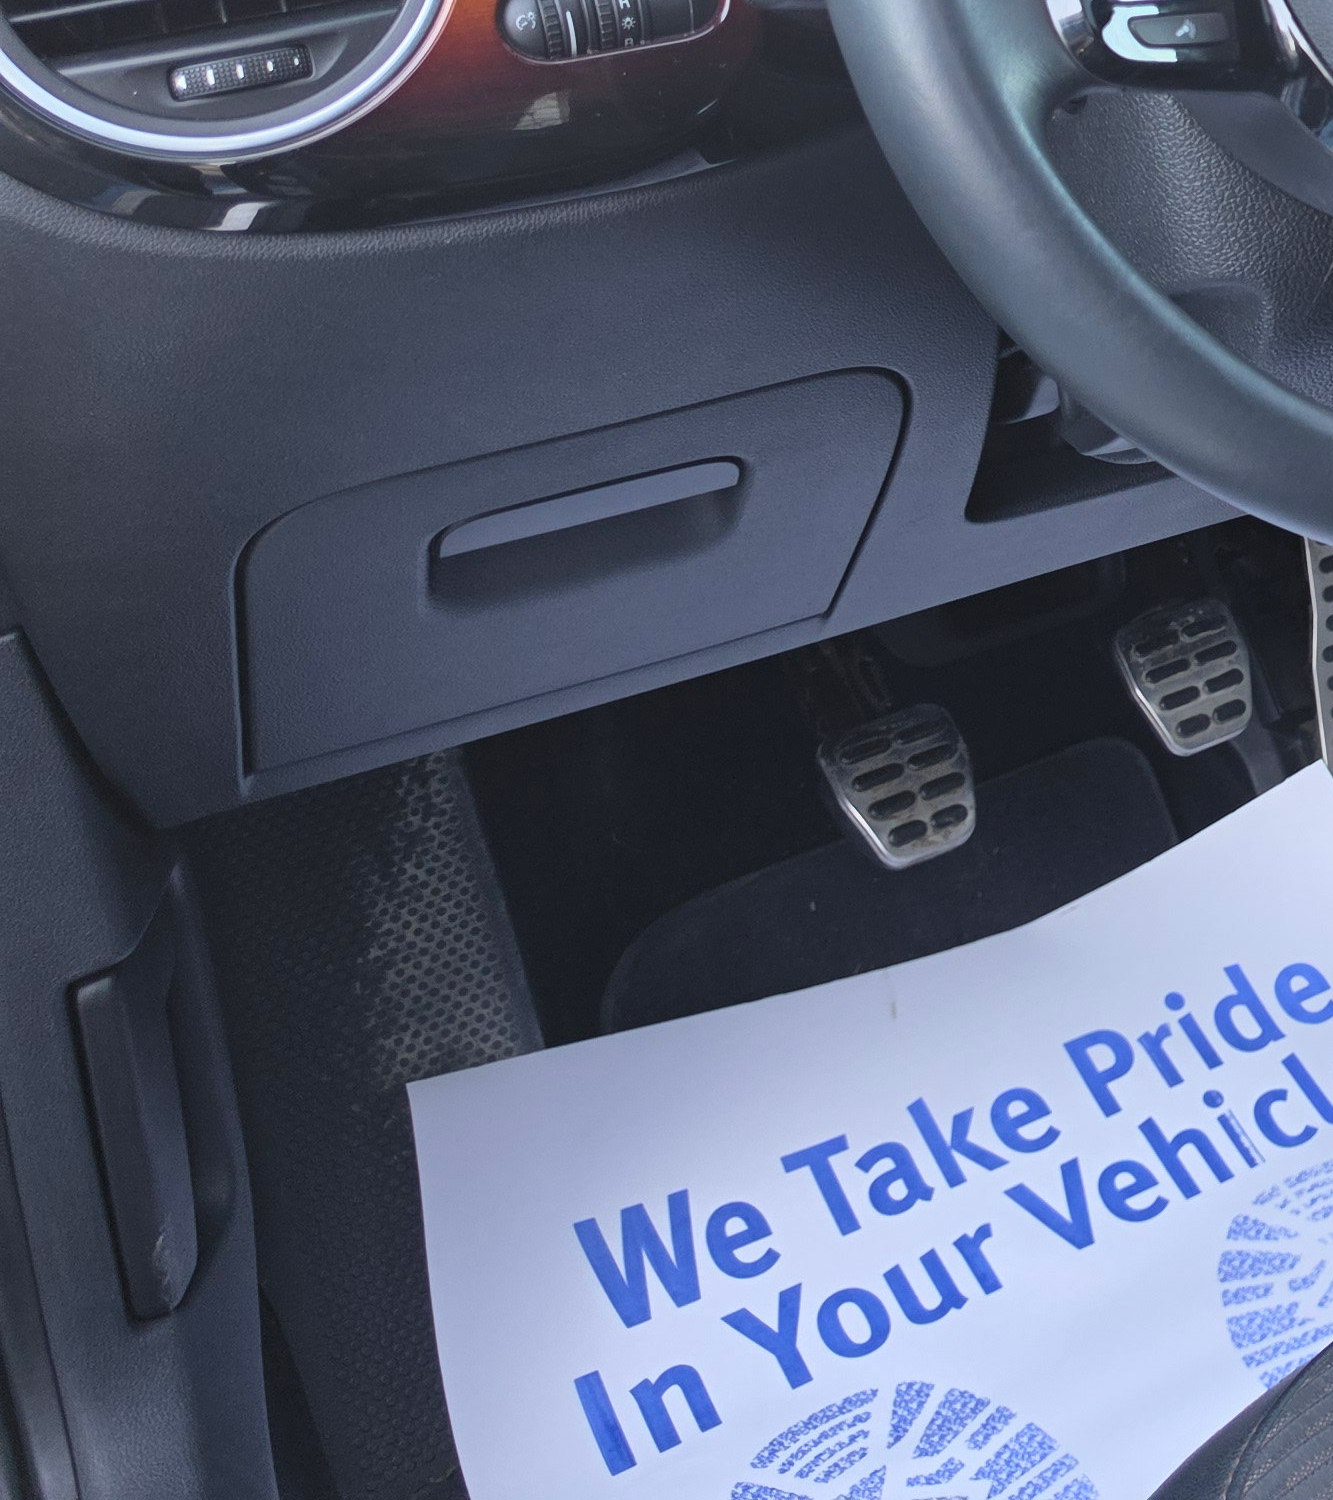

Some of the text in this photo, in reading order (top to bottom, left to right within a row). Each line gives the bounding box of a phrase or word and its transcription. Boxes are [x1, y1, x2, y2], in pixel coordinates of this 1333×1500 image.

[574, 1190, 781, 1328] We
[781, 1086, 1062, 1237] Take
[574, 1363, 722, 1476] In
[722, 1221, 1005, 1390] Your
